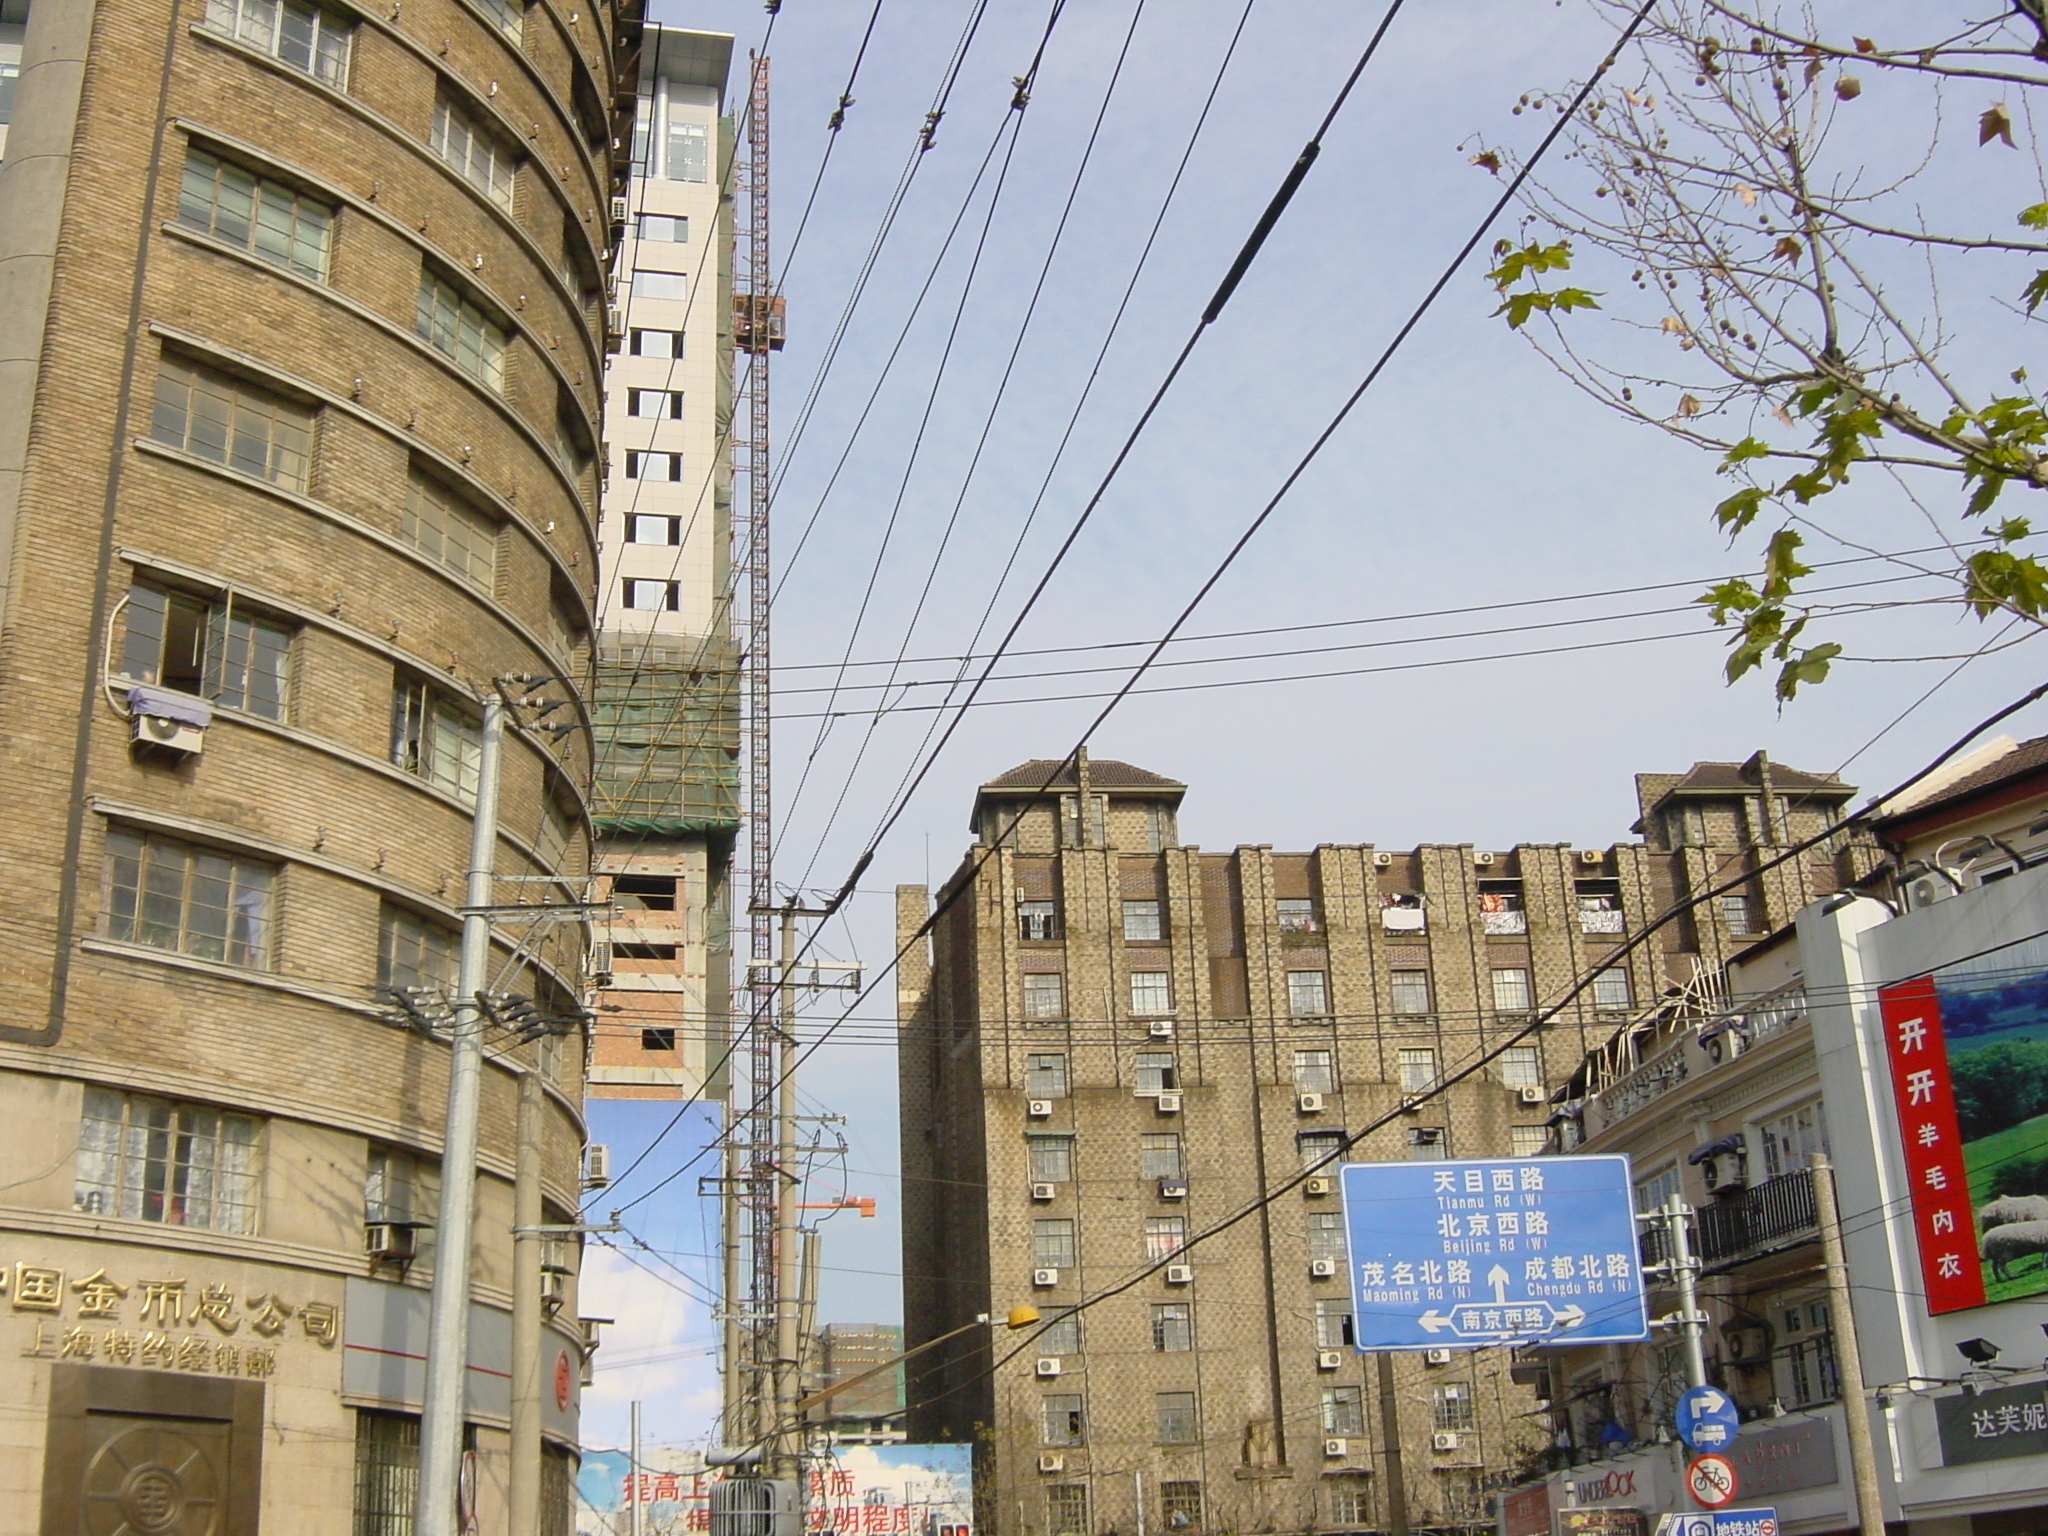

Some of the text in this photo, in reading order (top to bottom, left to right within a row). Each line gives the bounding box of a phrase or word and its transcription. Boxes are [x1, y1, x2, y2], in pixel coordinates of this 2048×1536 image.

[1898, 1017, 1962, 1279] 开开羊毛内衣
[1433, 1166, 1545, 1194] 天目西路
[1437, 1196, 1485, 1210] Tianmu
[1494, 1195, 1510, 1208] Rd
[1437, 1210, 1549, 1238] 北京西路
[1443, 1239, 1491, 1256] Beijing
[1499, 1238, 1515, 1252] Rd
[1361, 1258, 1472, 1287] 茂名北路
[1524, 1253, 1630, 1281] 成都北路
[1362, 1287, 1420, 1303] Maoming
[1428, 1286, 1444, 1301] Rd
[1526, 1281, 1581, 1298] Chengdu
[1587, 1280, 1604, 1294] Rd
[0, 1262, 339, 1346] 国金币总公司
[1461, 1308, 1544, 1331] 南京西路
[1971, 1403, 2048, 1439] 达芙妮
[1716, 1520, 1760, 1536] 地铁站
